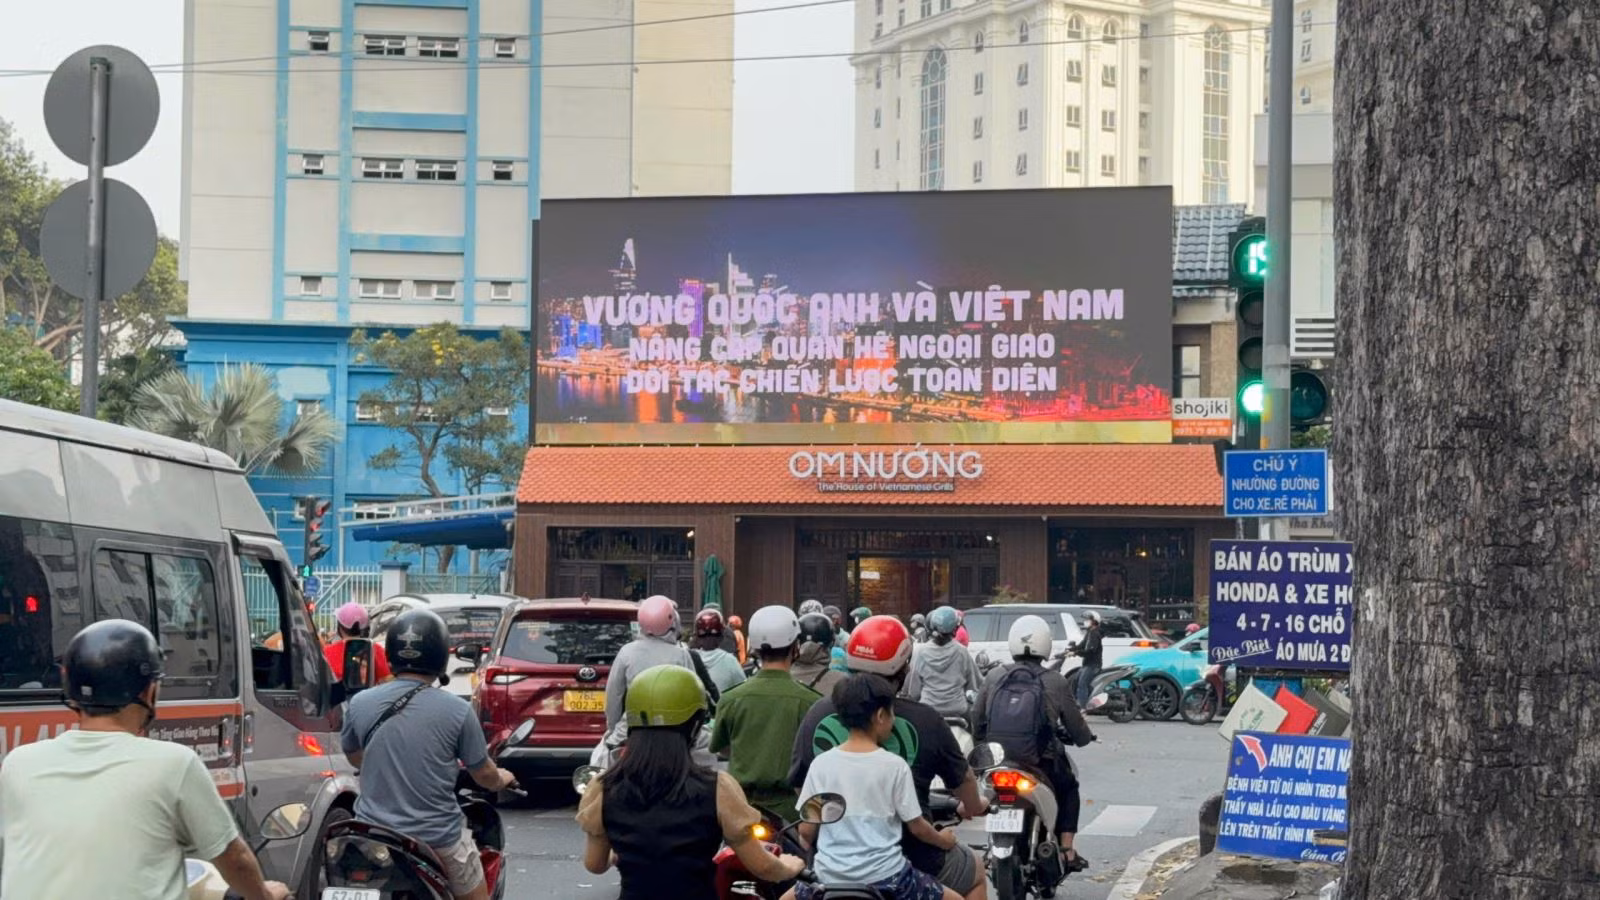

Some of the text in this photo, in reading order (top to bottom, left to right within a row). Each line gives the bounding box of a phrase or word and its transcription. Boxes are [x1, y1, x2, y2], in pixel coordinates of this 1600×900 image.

[582, 280, 1125, 329] VƯƠNG QUỐC ANH VÀ VIỆT NAM
[900, 334, 982, 364] NGOẠI
[991, 333, 1056, 359] GIAO
[740, 361, 819, 393] CHIẾN
[907, 359, 983, 392] TOÀN
[992, 362, 1057, 397] DIỆN
[1174, 400, 1228, 418] shojiki
[1288, 454, 1298, 472] Ý
[836, 482, 864, 491] House
[866, 482, 876, 491] of
[879, 482, 932, 492] Vietnamese
[1231, 474, 1320, 491] NHƯỜNG ĐƯỜNG
[1232, 497, 1255, 510] CHO
[1291, 493, 1317, 510] PHẢI
[1214, 545, 1252, 571] BÁN
[1256, 546, 1282, 572] ÁO
[1287, 547, 1340, 573] TRÙM
[1216, 582, 1280, 603] HONDA
[1284, 583, 1298, 604] &
[1304, 583, 1329, 604] XE
[1236, 612, 1247, 632] 4
[1260, 613, 1271, 632] 7
[1285, 614, 1305, 633] 16
[1308, 607, 1345, 634] CHỖ
[1275, 637, 1294, 661] ÁO
[1330, 644, 1339, 662] 2
[1268, 743, 1294, 768] ANH
[1294, 744, 1316, 775] CHỊ
[1316, 746, 1337, 771] EM
[1227, 774, 1249, 794] BỆNH
[1250, 775, 1269, 796] VIỆN
[1315, 783, 1337, 799] THEO
[1224, 795, 1247, 815] THẤY
[1247, 799, 1264, 817] NHÀ
[1283, 804, 1301, 819] CAO
[1300, 803, 1321, 820] MÀU
[1219, 818, 1237, 837] LÊN
[1238, 820, 1261, 839] TRÊN
[1261, 821, 1284, 840] THẤY
